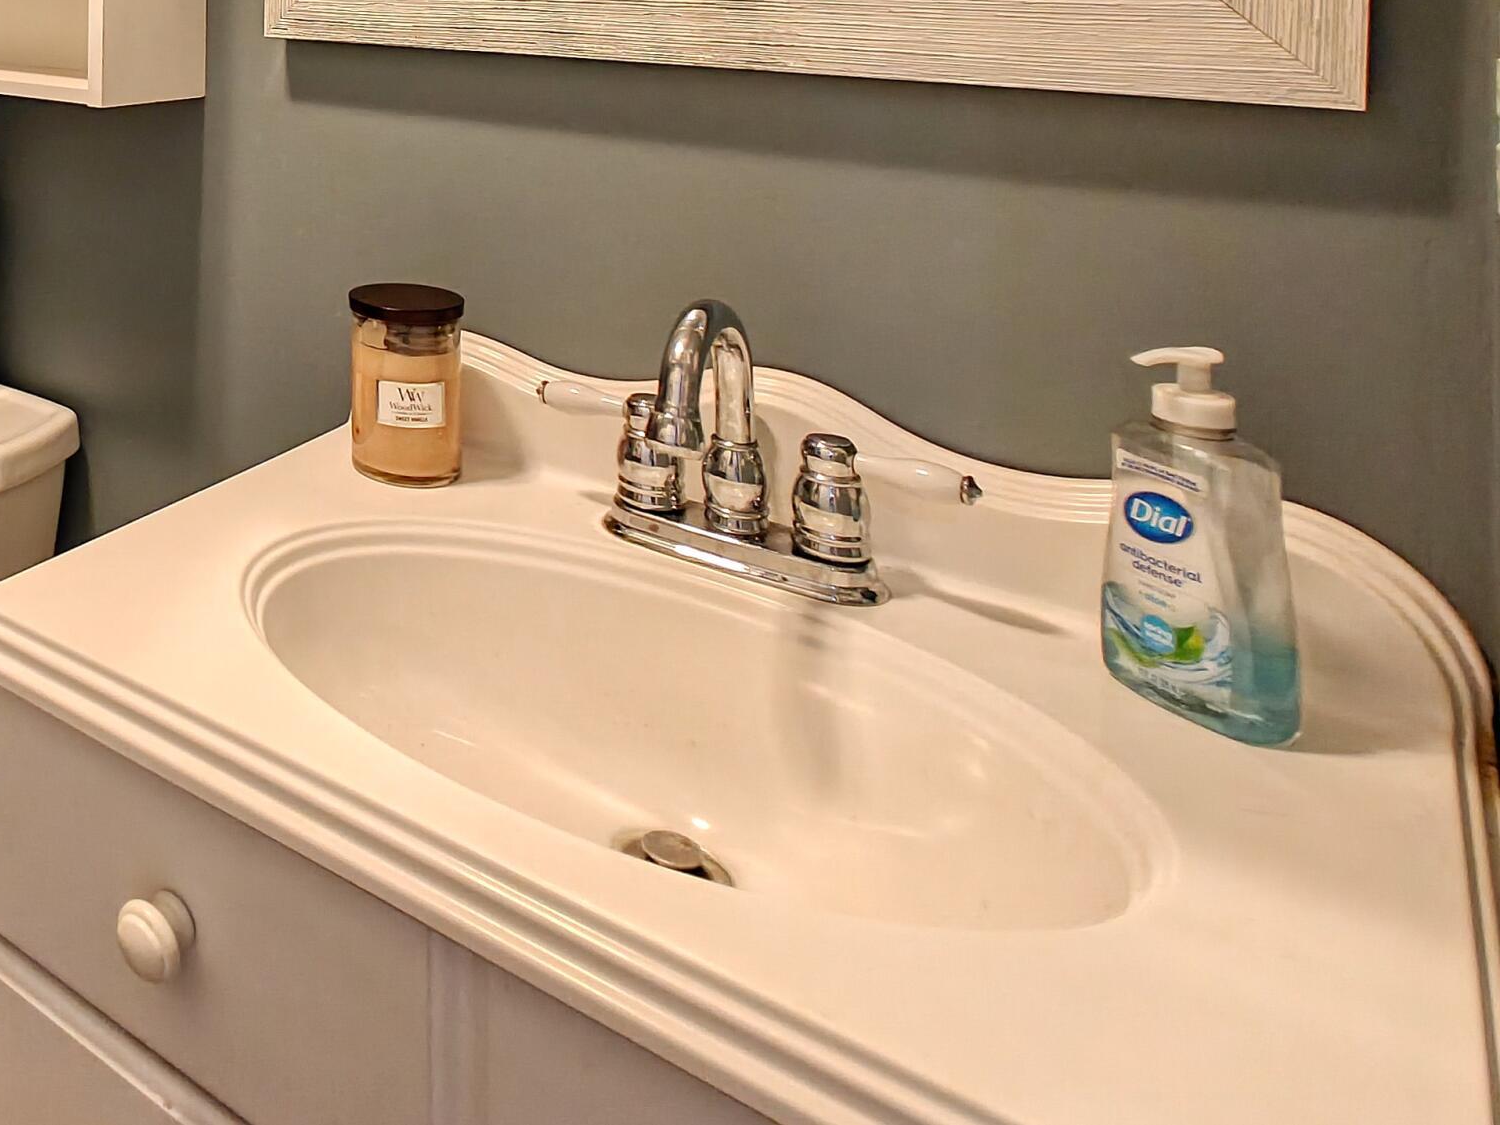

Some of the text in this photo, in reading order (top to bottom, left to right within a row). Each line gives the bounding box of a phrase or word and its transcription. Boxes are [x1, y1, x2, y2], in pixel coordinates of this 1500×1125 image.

[1130, 497, 1189, 538] Dial
[1119, 542, 1203, 584] antibacterial
[1131, 559, 1183, 588] defense
